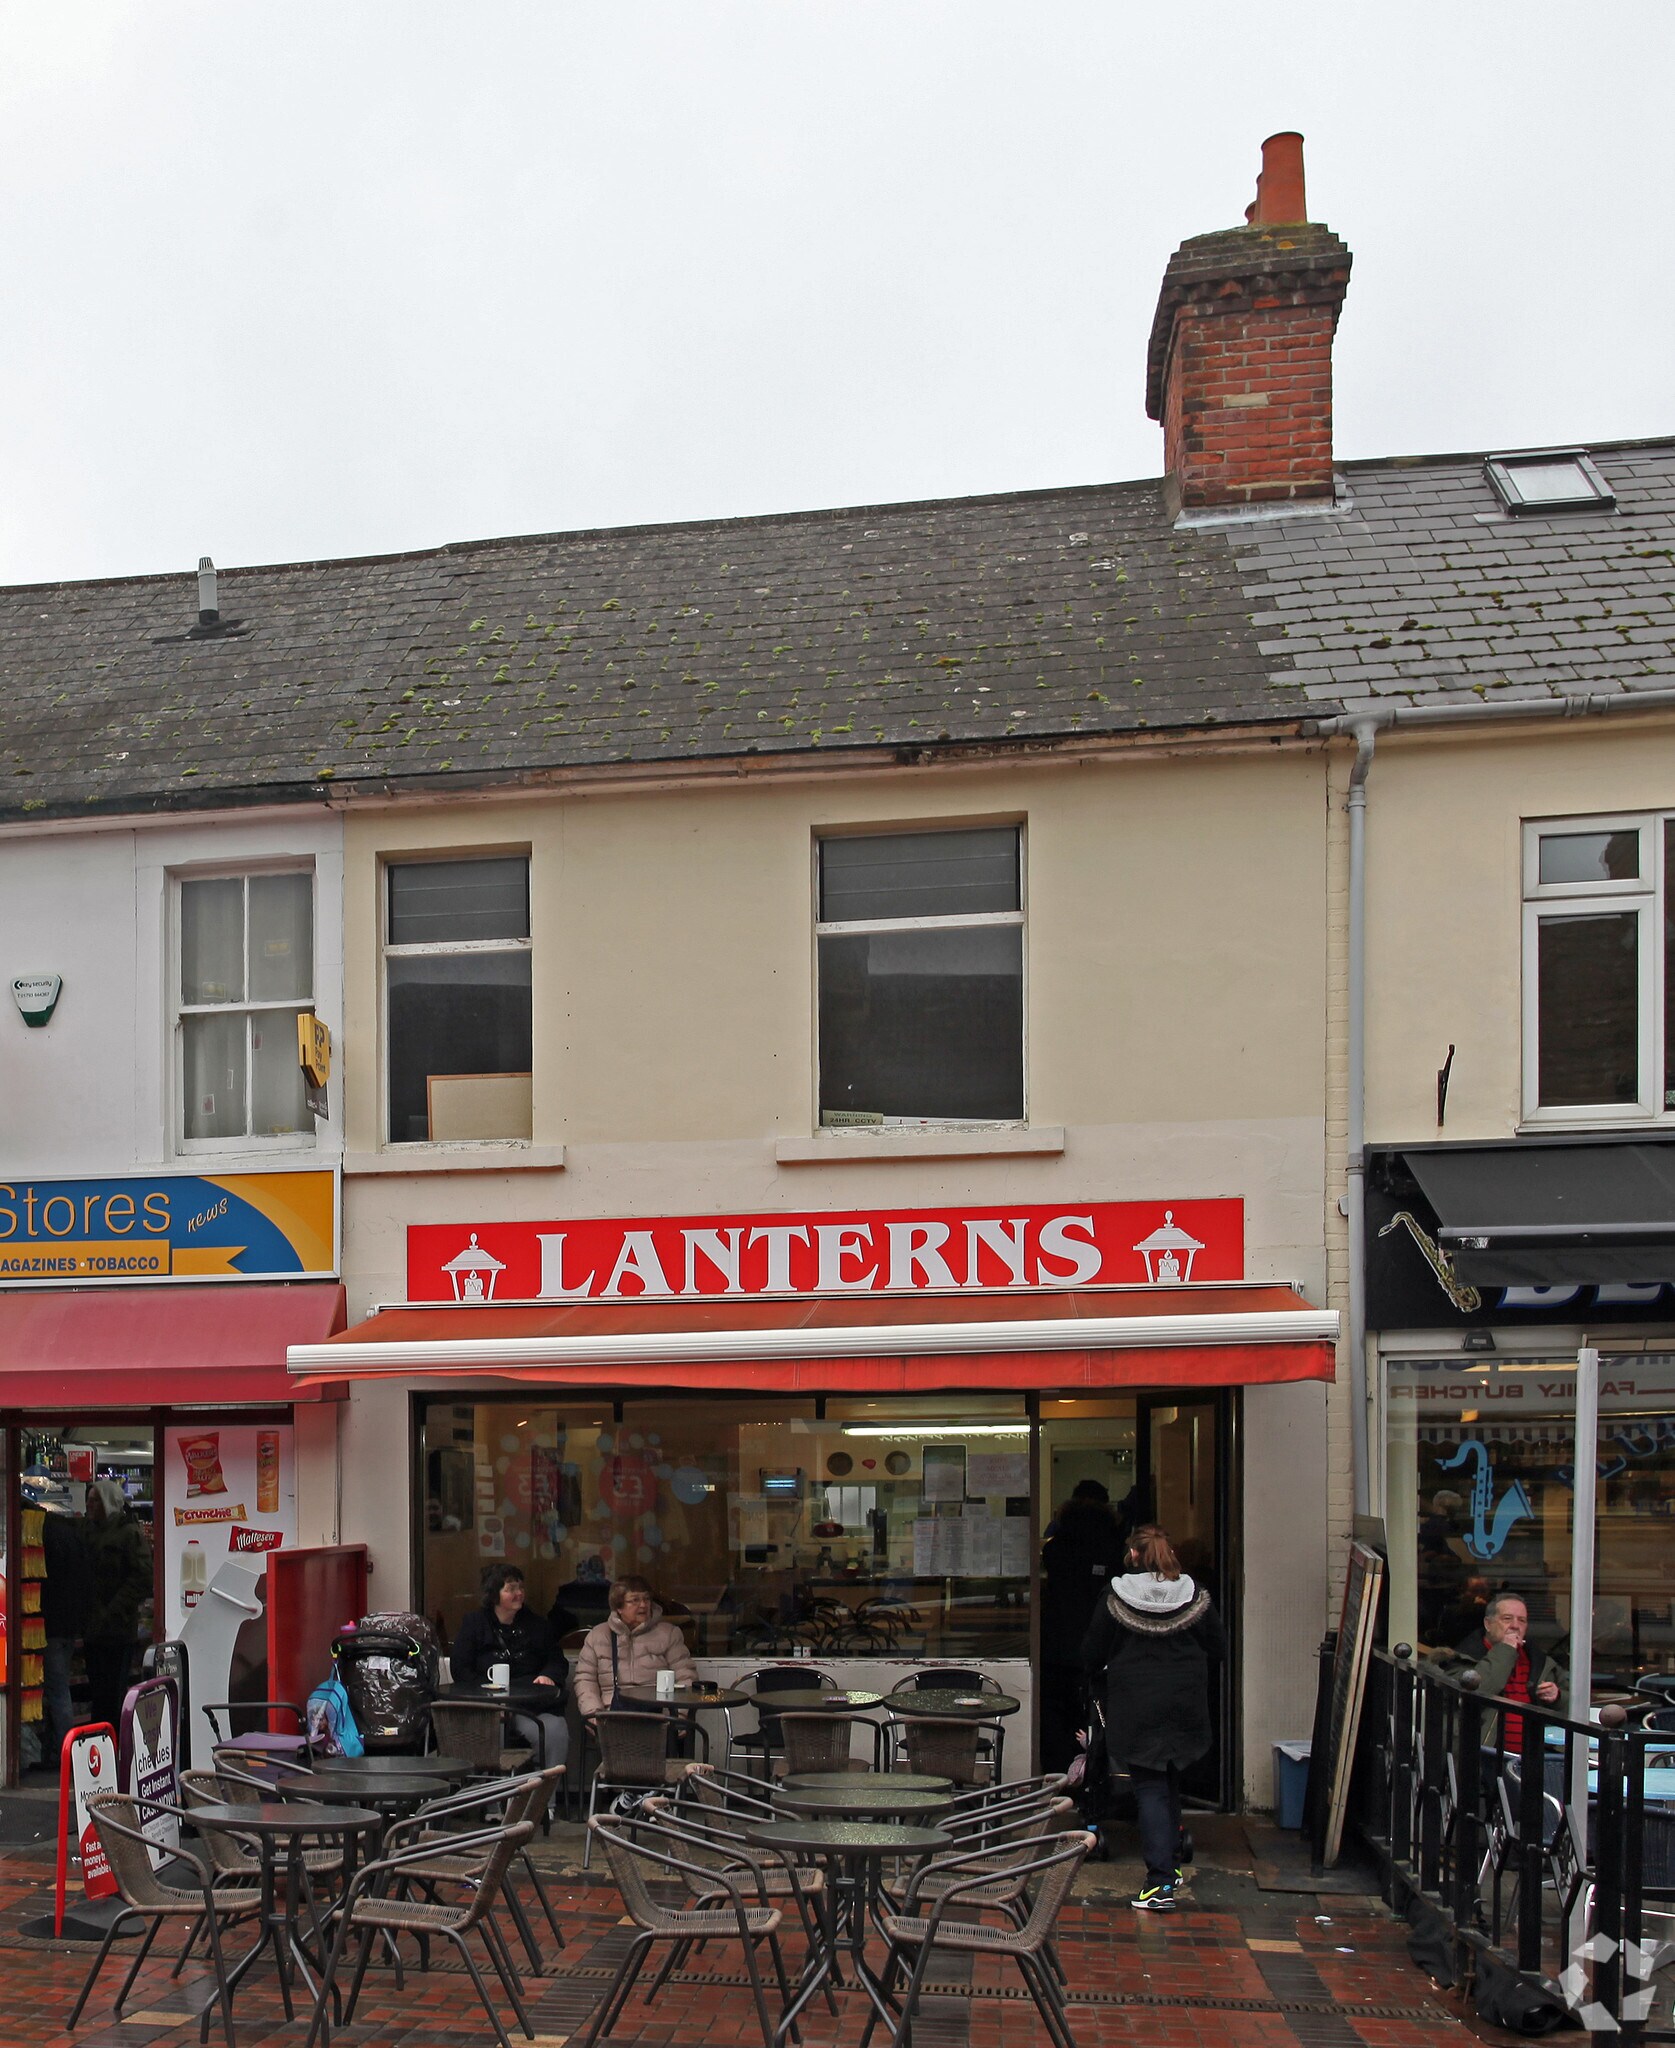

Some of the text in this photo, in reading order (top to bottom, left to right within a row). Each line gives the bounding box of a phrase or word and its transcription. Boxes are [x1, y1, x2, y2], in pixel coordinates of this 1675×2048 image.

[0, 1184, 171, 1238] Stores
[186, 1197, 229, 1233] news
[86, 1257, 160, 1271] TOBACCO
[535, 1215, 1104, 1299] LANTERNS
[236, 1532, 275, 1552] Maltesers
[141, 1773, 171, 1798] Get Instant
[85, 1841, 97, 1853] Fast
[84, 1854, 101, 1867] money
